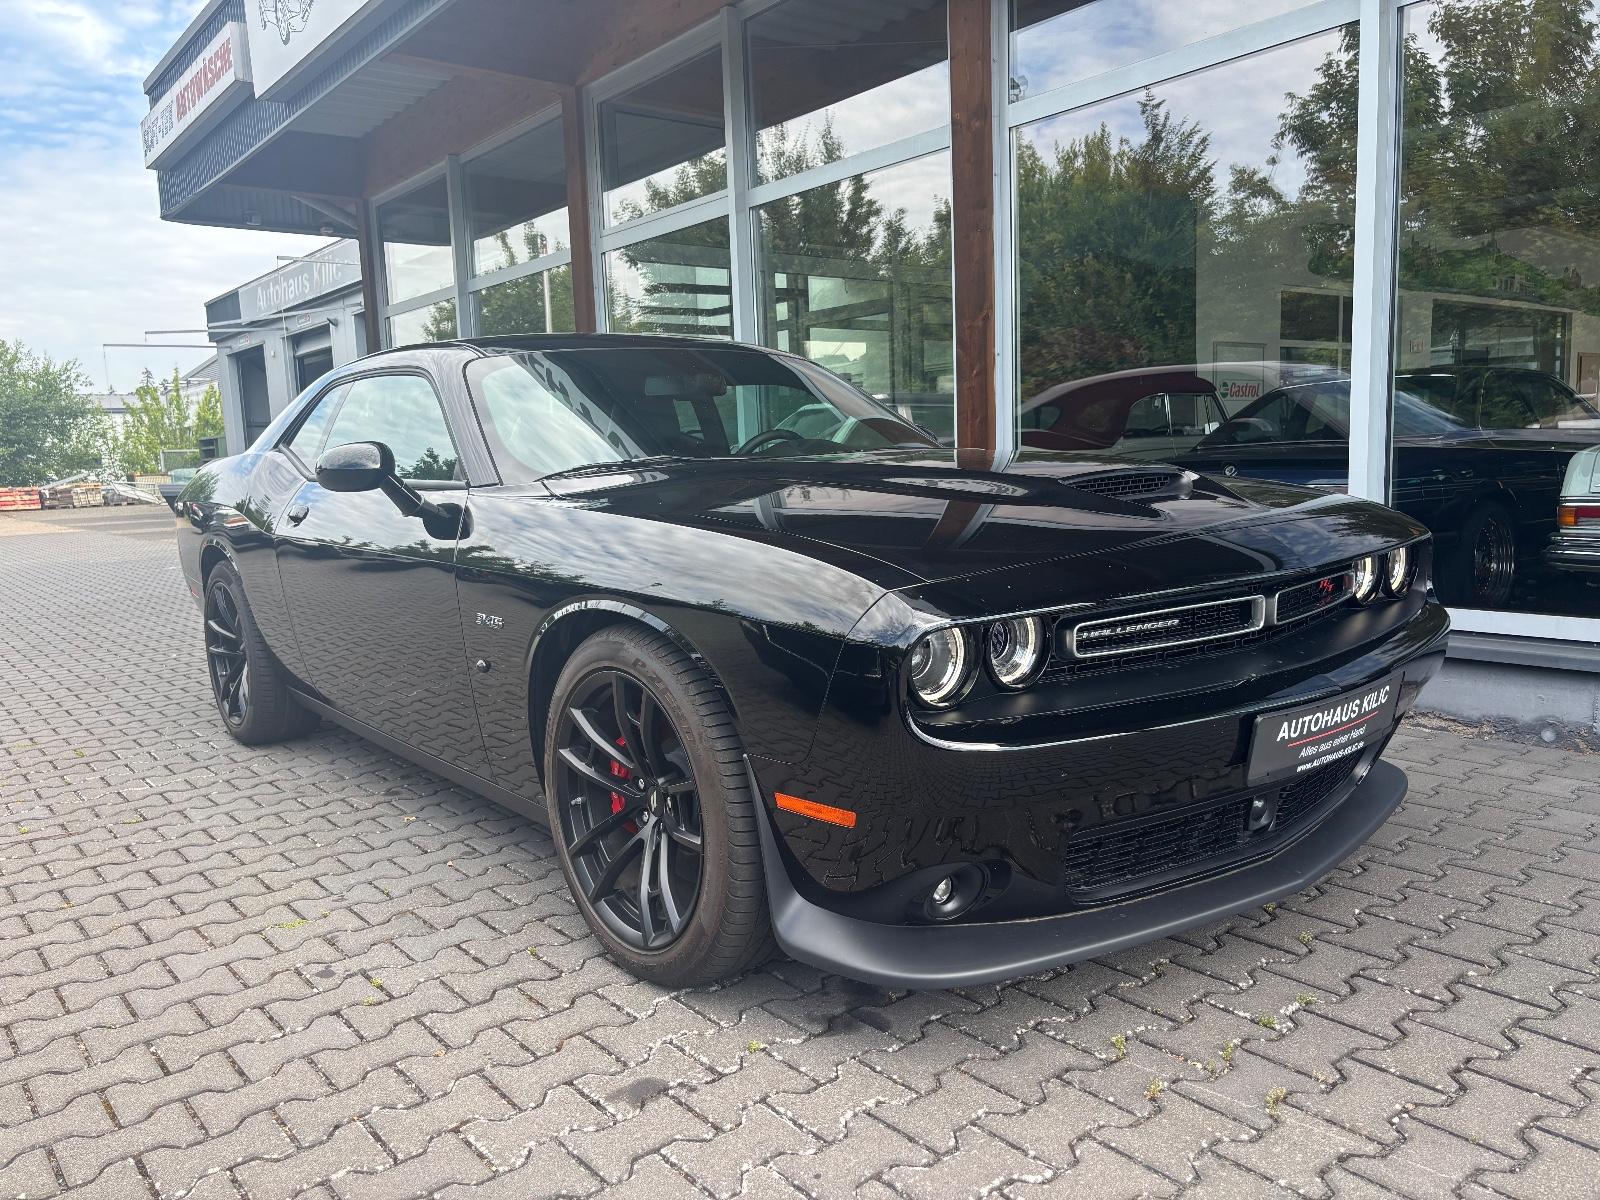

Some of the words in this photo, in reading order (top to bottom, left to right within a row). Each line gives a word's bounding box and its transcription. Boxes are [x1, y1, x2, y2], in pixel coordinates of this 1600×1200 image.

[256, 271, 310, 313] Autohaus
[1229, 382, 1261, 398] Castrol
[1276, 698, 1360, 742] AUTOHAUS
[1361, 685, 1390, 714] KILIC
[1298, 745, 1319, 759] Alles
[1318, 740, 1333, 752] aus
[1332, 733, 1350, 747] einer
[1349, 723, 1367, 740] Hand
